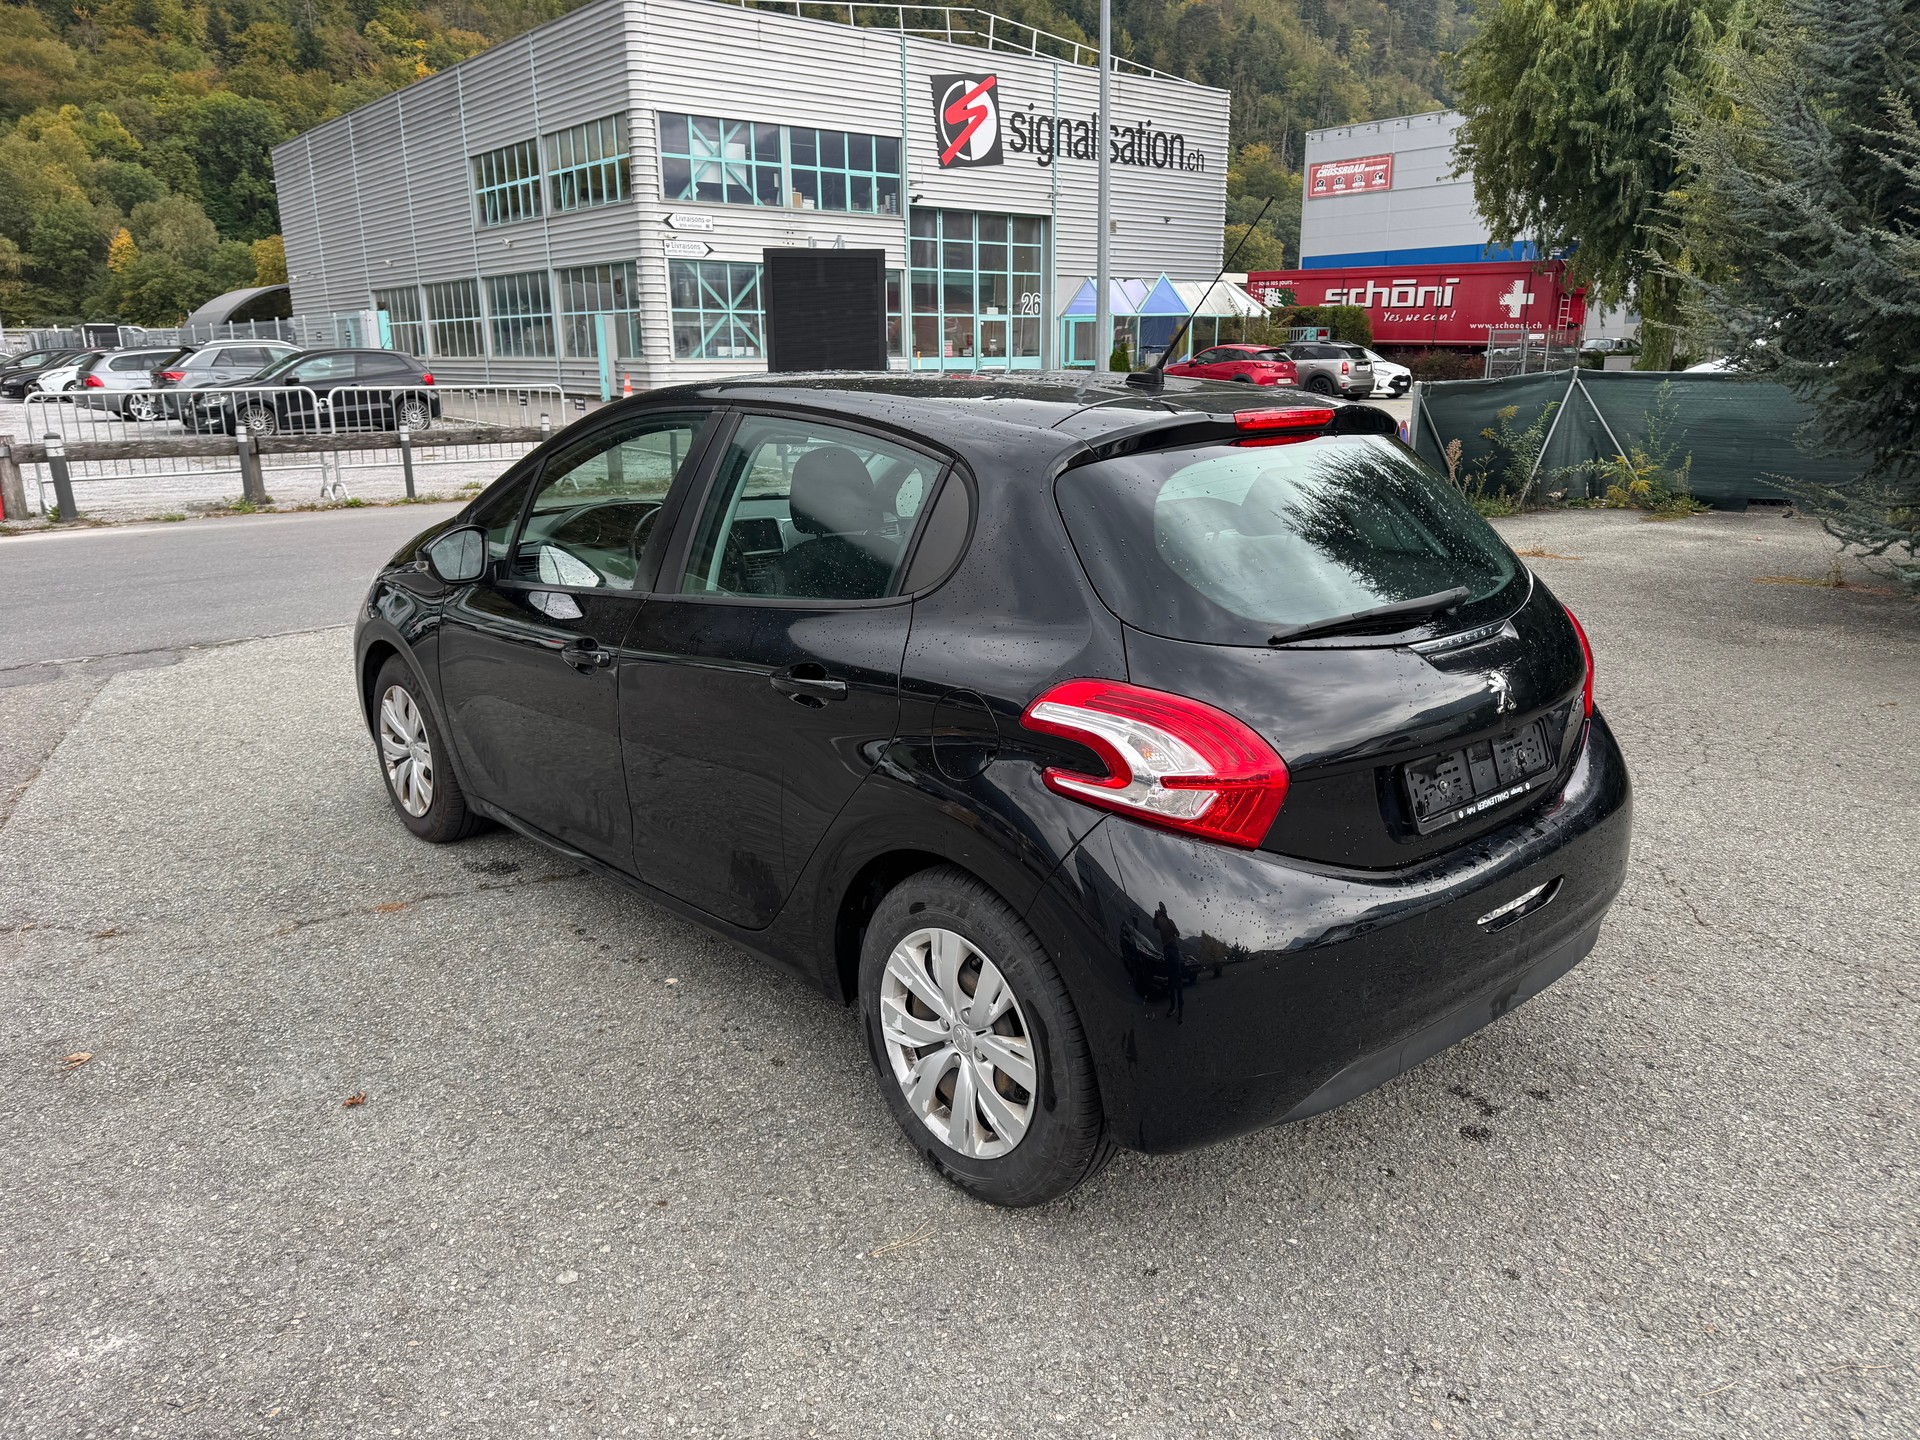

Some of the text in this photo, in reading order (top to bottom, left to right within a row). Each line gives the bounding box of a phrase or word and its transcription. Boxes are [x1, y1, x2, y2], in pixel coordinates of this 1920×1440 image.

[1010, 102, 1205, 172] signalsation.ch
[675, 215, 705, 223] Livraisons
[671, 242, 700, 250] Livraisons
[1021, 293, 1041, 315] 26
[1406, 313, 1420, 322] we
[1477, 792, 1509, 811] CHALLENGER
